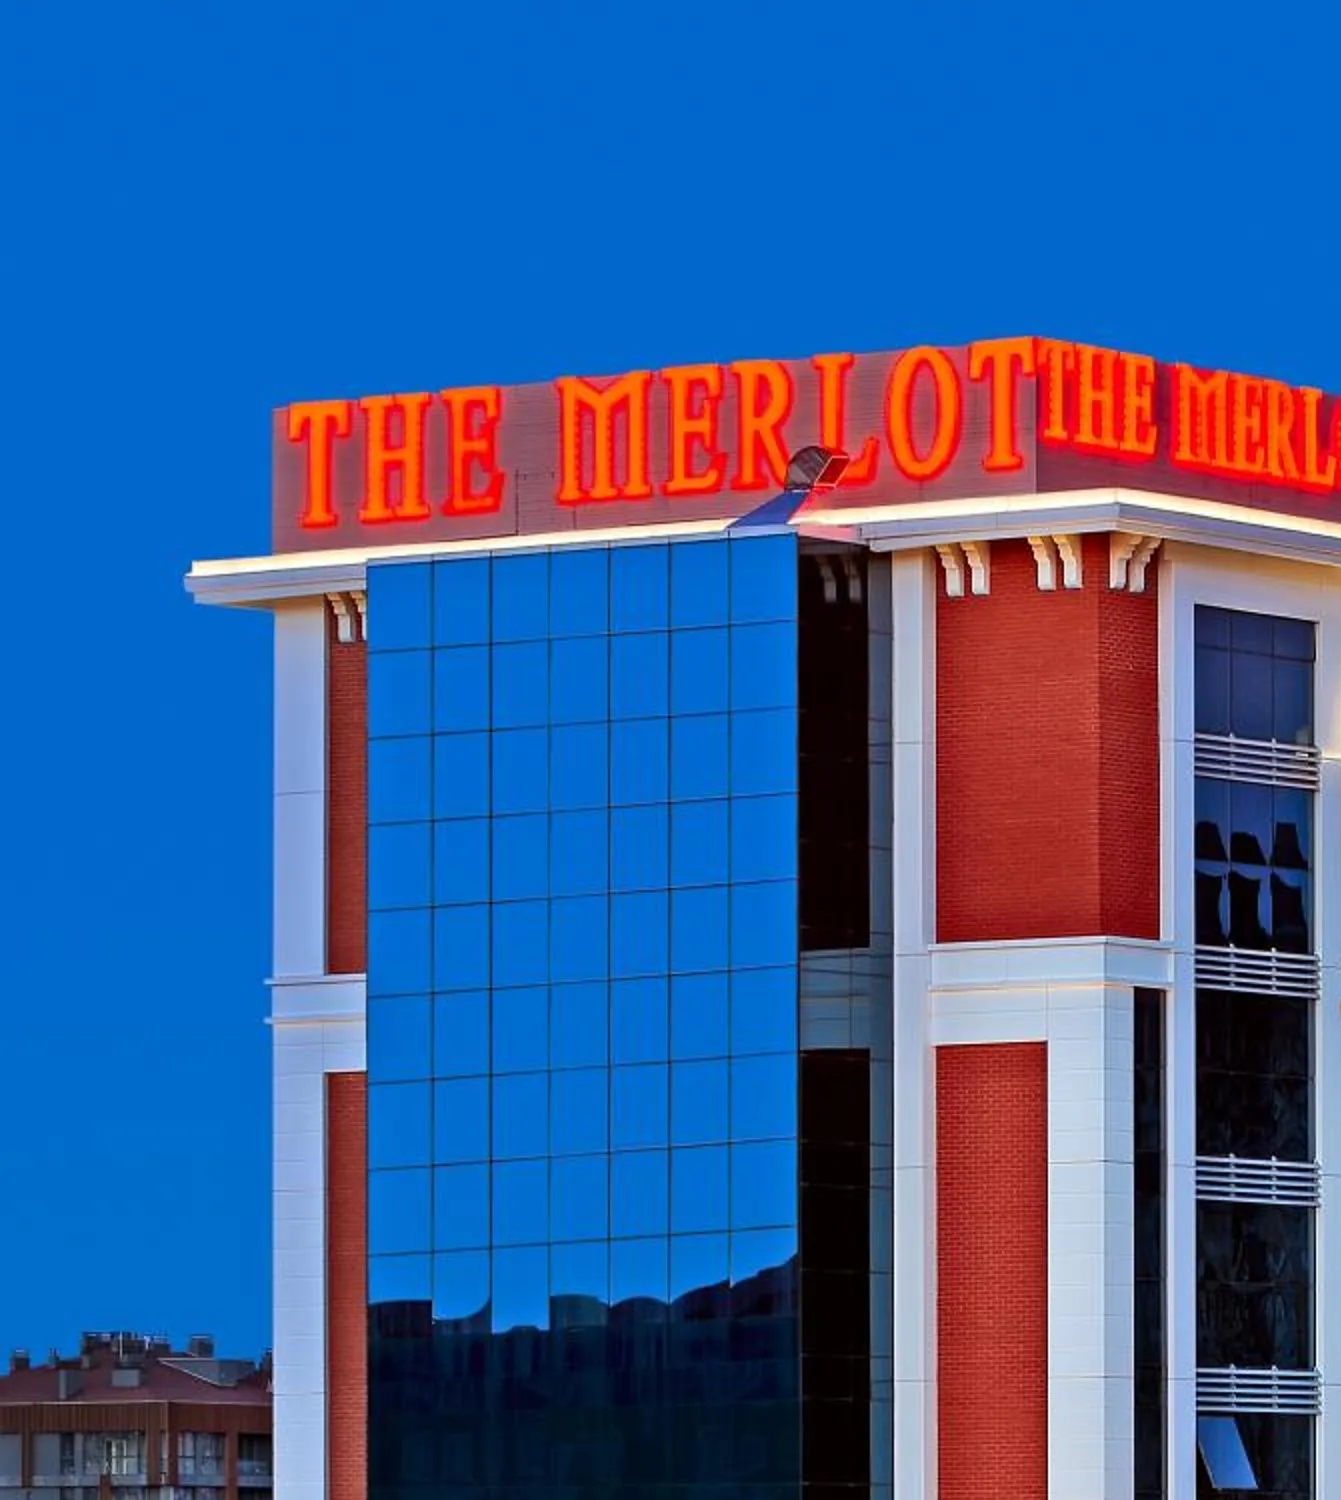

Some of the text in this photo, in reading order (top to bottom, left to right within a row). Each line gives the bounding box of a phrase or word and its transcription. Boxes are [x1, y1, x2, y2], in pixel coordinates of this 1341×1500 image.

[287, 336, 1037, 527] THE MERLOT
[1036, 337, 1157, 457] THE
